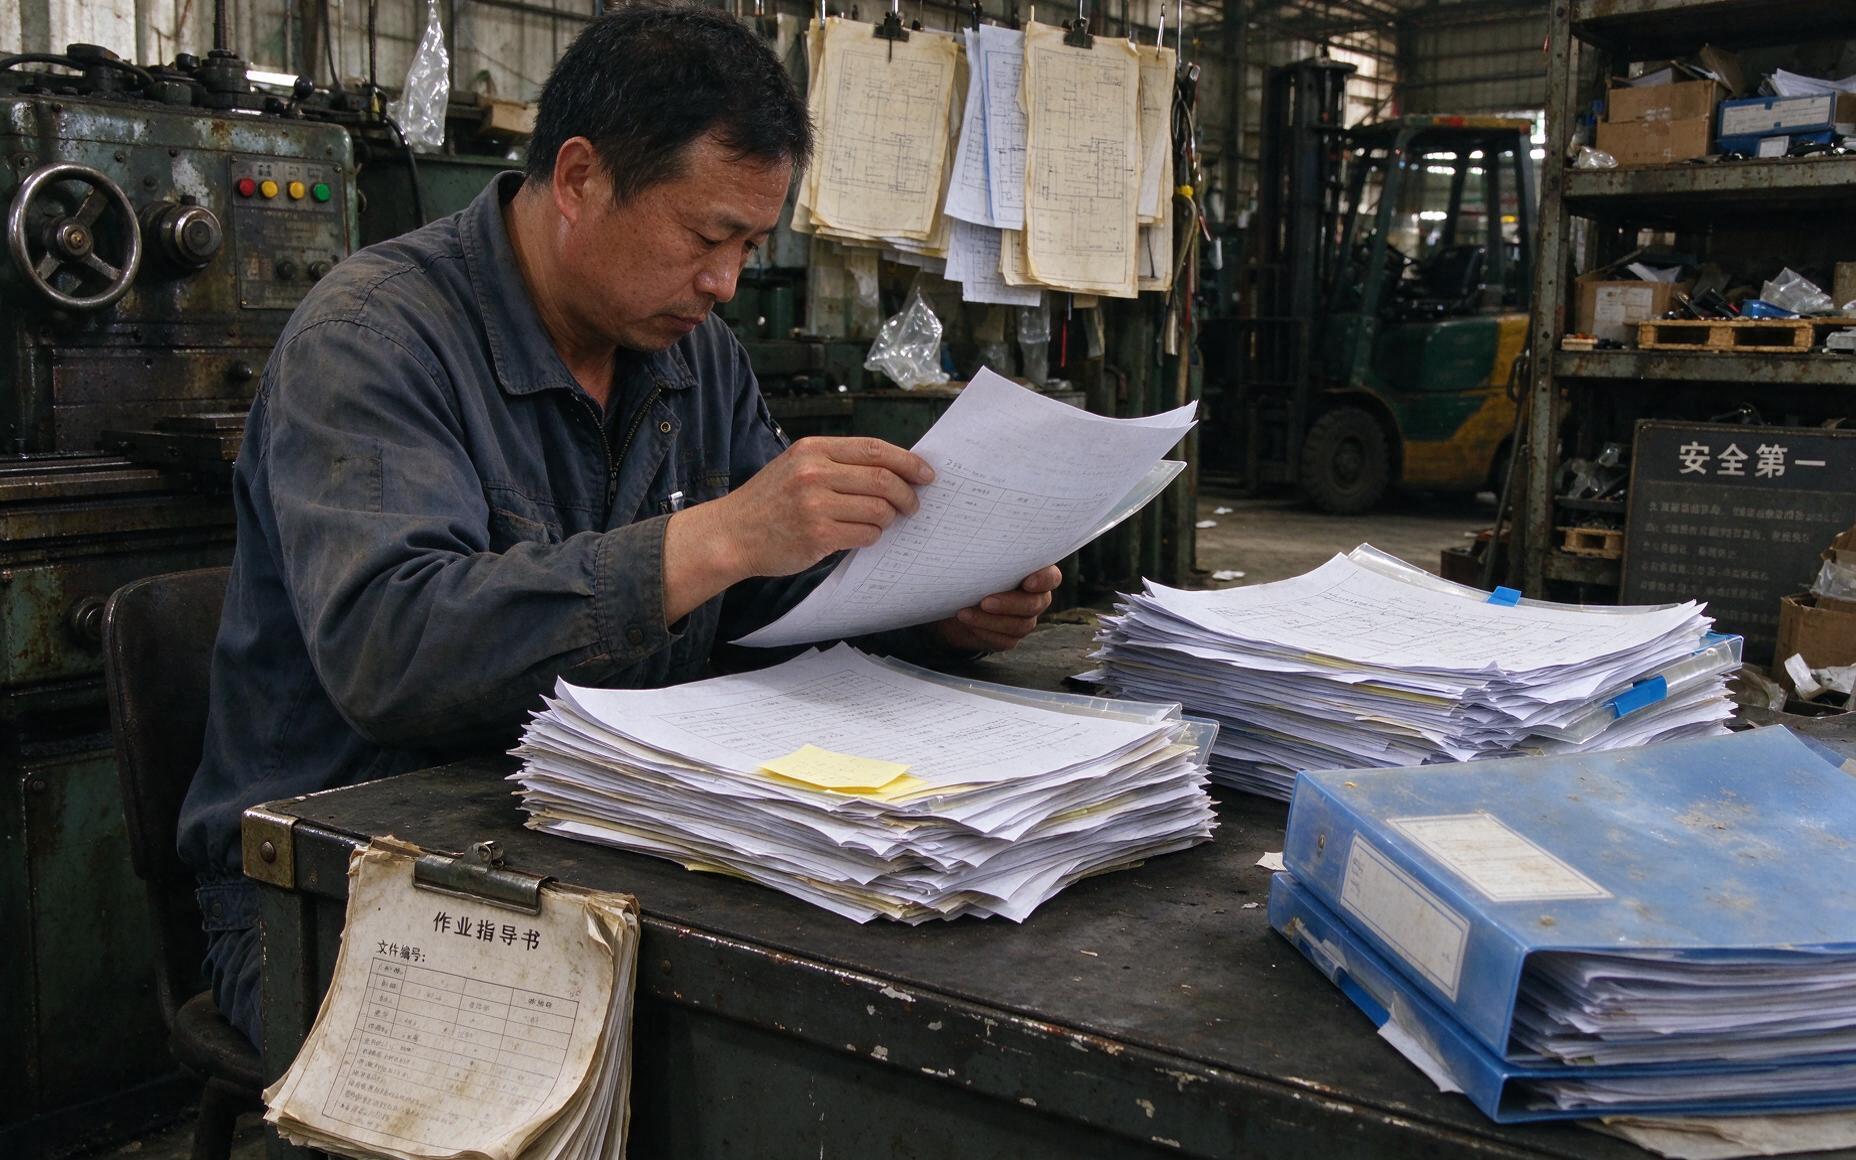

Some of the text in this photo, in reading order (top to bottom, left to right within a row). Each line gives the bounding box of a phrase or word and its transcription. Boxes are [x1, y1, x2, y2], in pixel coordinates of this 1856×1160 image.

[1679, 441, 1826, 478] 安全第一
[433, 911, 541, 951] 作业指导书
